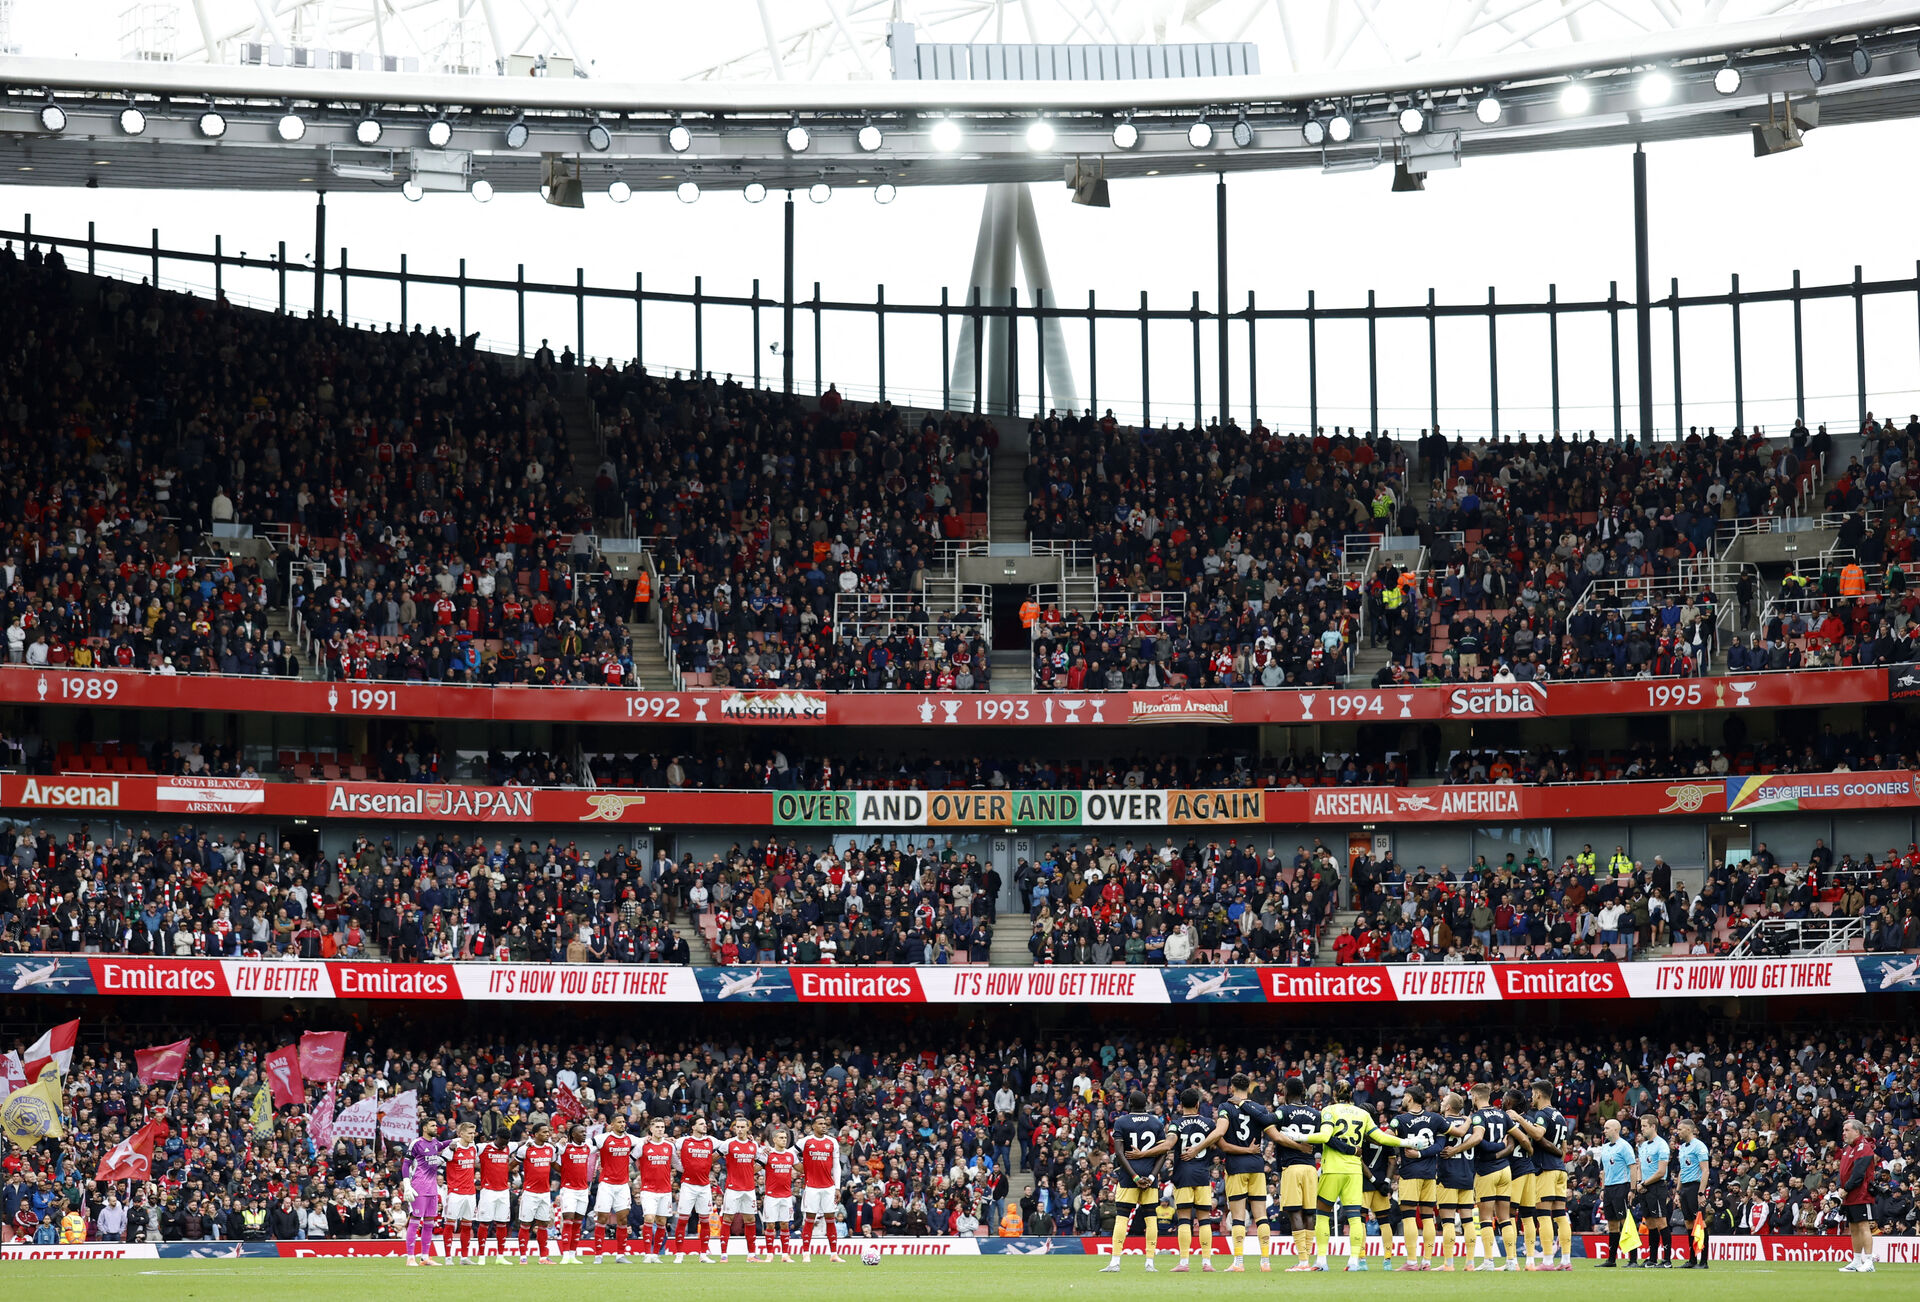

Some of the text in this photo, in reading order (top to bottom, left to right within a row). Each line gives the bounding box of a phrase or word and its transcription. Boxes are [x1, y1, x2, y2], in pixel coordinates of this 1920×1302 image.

[61, 678, 119, 700] 1989
[350, 689, 397, 712] 1991
[1648, 685, 1702, 708] 1995
[625, 696, 680, 719] 1992
[975, 700, 1030, 721] 1993
[1132, 700, 1228, 714] Mizoram Arsenal
[1329, 694, 1384, 717] 1994
[1451, 688, 1535, 714] Serbia
[722, 705, 825, 722] AUSTRIA SC
[20, 778, 120, 807] Arsenal
[170, 778, 251, 789] COSTA BLANCA
[1758, 782, 1910, 800] SEYCHELLES GOONERS
[185, 803, 236, 813] ARSENAL
[329, 786, 533, 817] Arsenal JAPAN
[777, 792, 1260, 821] OVER AND OVER AND OVER AGAIN
[1315, 789, 1518, 816] ARSENAL AMERICA
[637, 839, 648, 850] 54
[995, 841, 1006, 852] 55
[1017, 841, 1028, 852] 55
[1377, 838, 1387, 848] 56
[103, 964, 215, 993] Emirates
[236, 967, 319, 991] FLY BETTER
[340, 968, 448, 994] Emirates
[488, 969, 667, 995] IT'S HOW YOU GET THERE
[802, 970, 911, 997] Emirates
[954, 973, 1135, 996] IT'S HOW YOU GET THERE
[1272, 970, 1382, 997] Emirates
[1402, 971, 1485, 995] FLY BETTER
[1506, 969, 1613, 994] Emirates
[1656, 963, 1832, 991] IT'S HOW YOU GET THERE
[1236, 1113, 1251, 1141] 3
[1334, 1118, 1364, 1146] 23
[1488, 1122, 1504, 1144] 11
[1129, 1130, 1156, 1152] 12
[1180, 1132, 1208, 1159] 18
[1369, 1143, 1383, 1169] 7
[1771, 1242, 1854, 1262] Emirates
